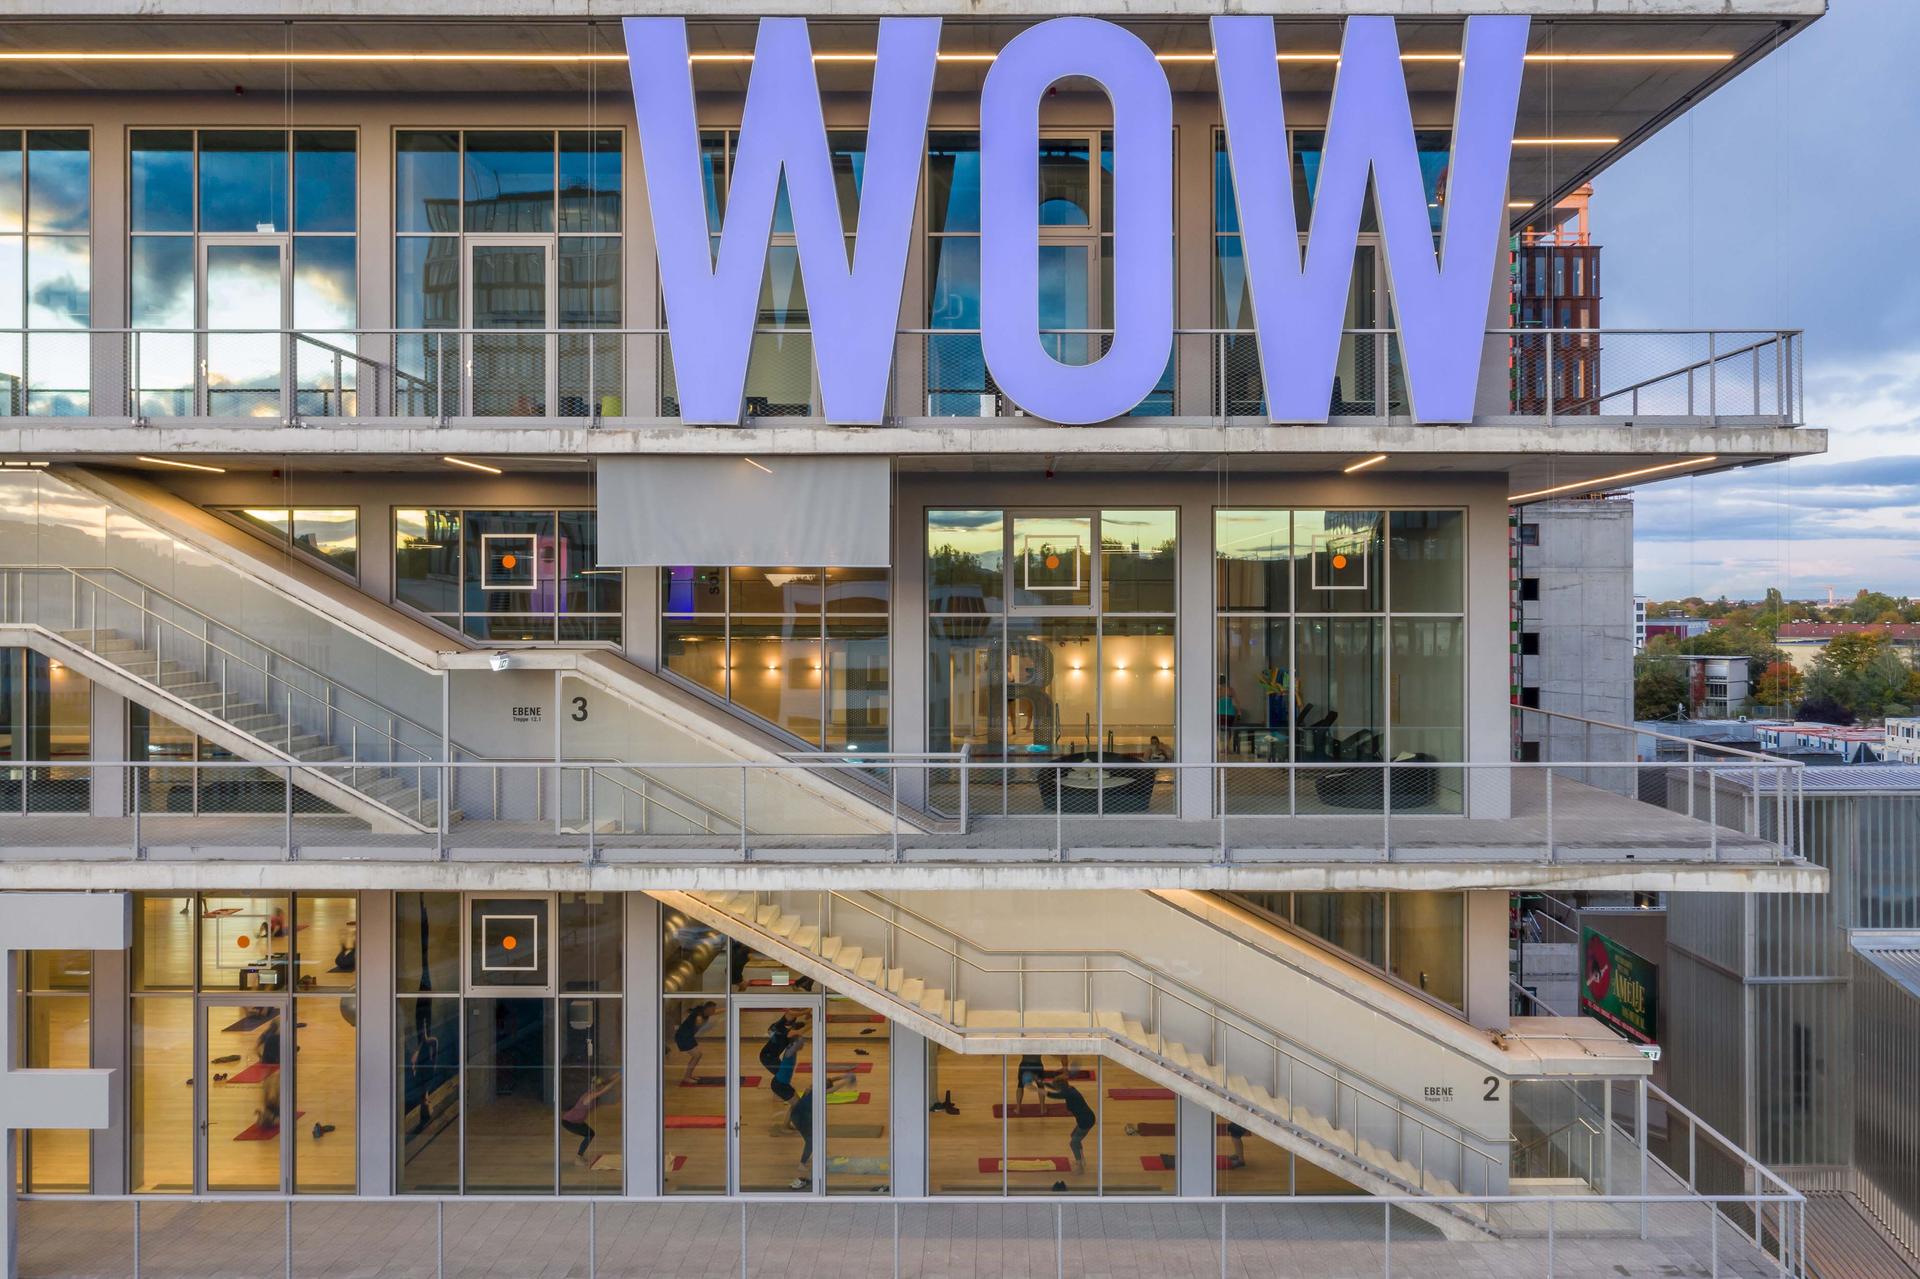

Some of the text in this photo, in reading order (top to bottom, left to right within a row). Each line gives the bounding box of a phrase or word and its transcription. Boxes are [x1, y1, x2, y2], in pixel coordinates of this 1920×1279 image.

[622, 14, 1532, 427] WOW
[512, 696, 588, 721] EBENE 3
[1424, 1076, 1500, 1101] EBENE 2
